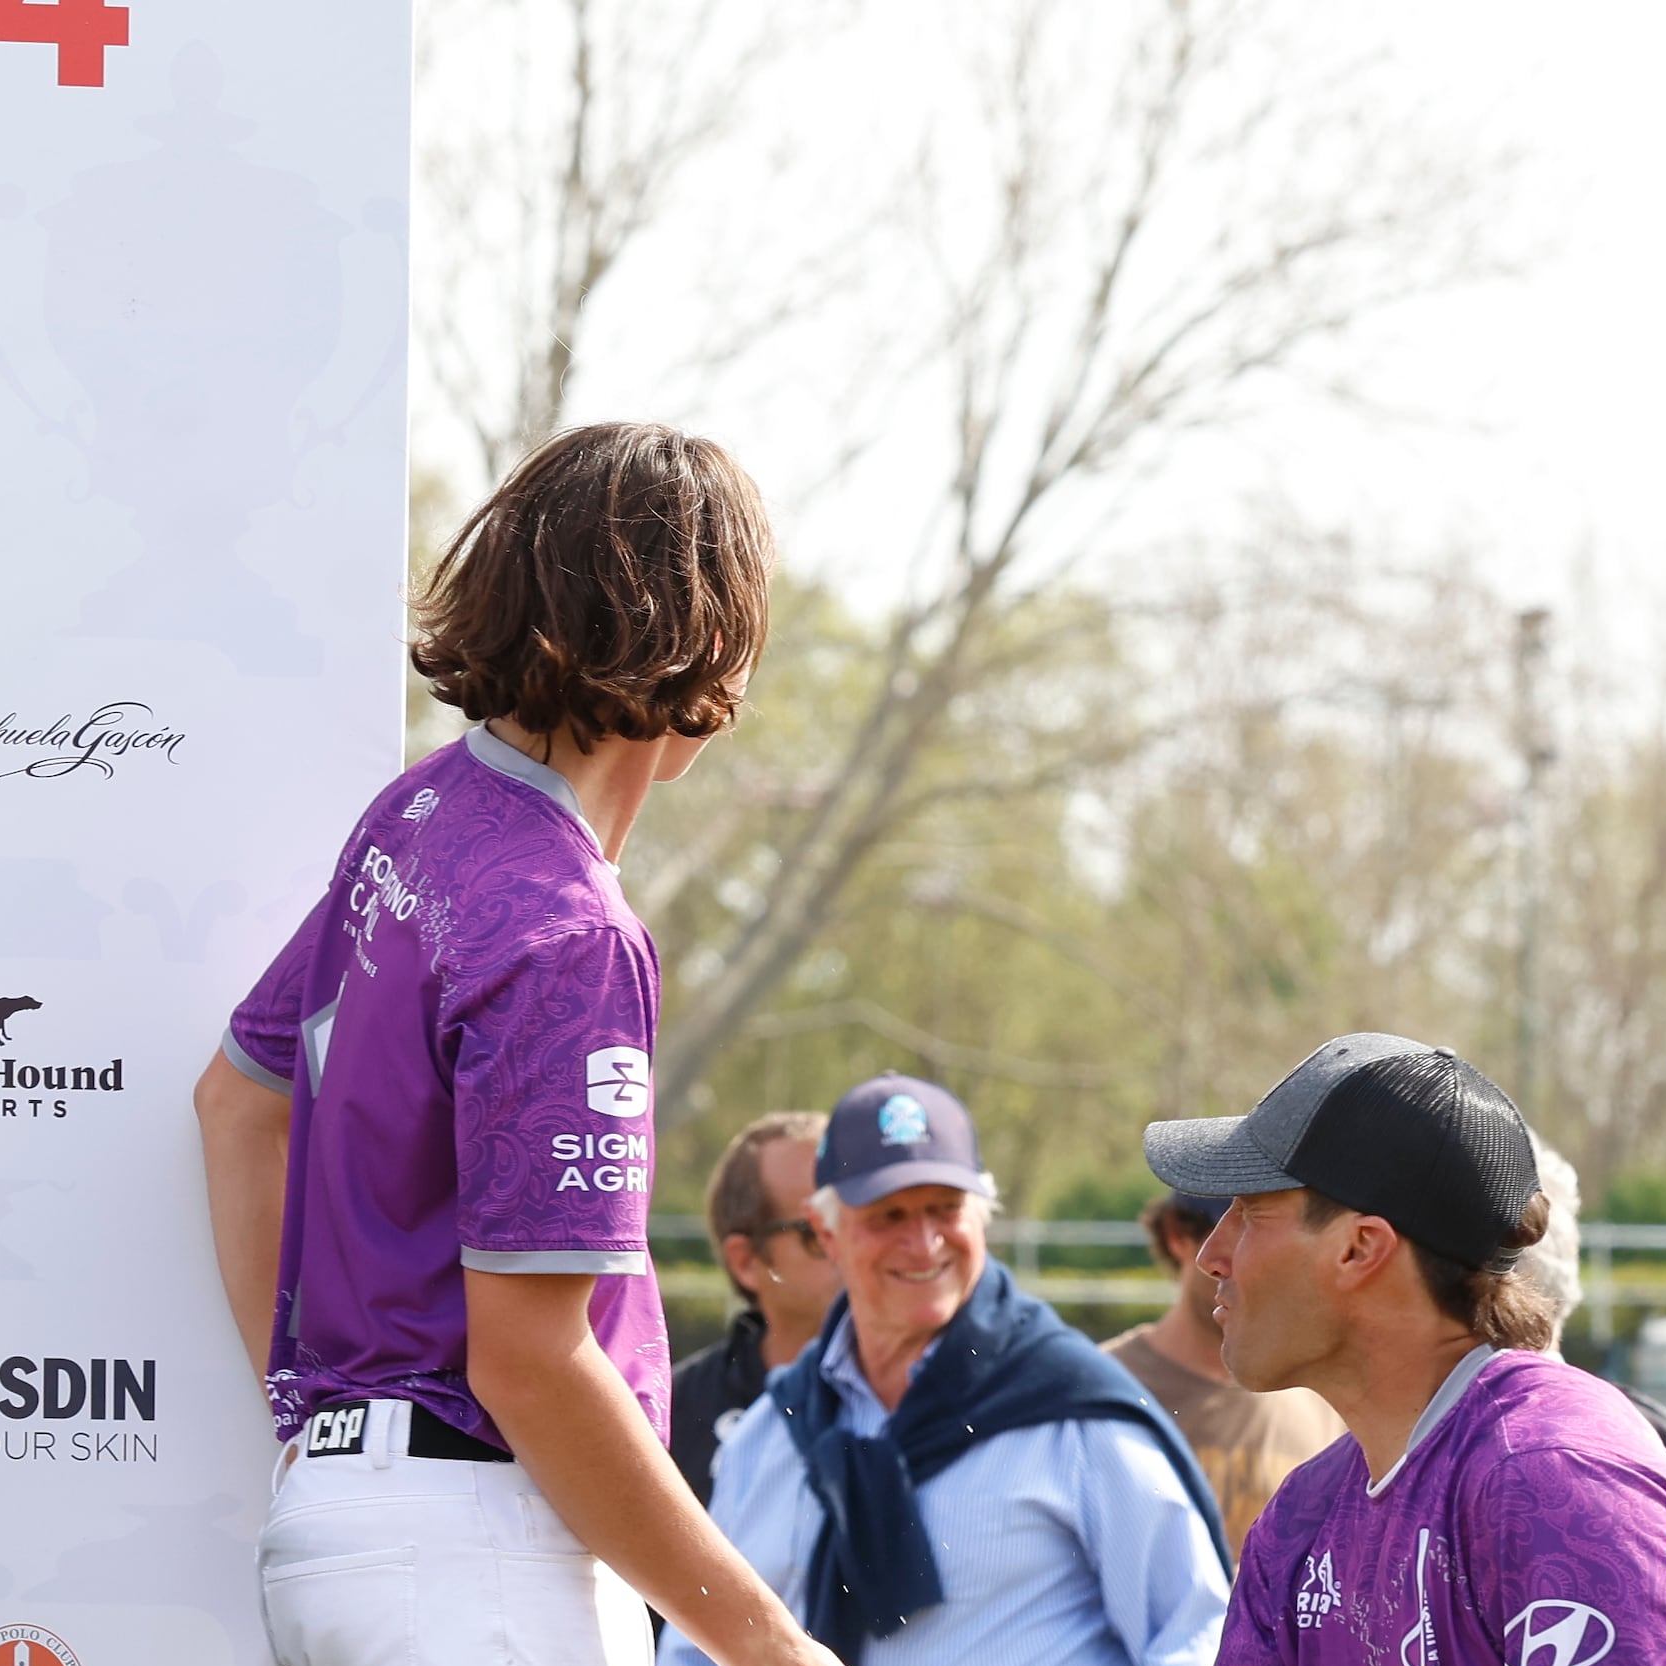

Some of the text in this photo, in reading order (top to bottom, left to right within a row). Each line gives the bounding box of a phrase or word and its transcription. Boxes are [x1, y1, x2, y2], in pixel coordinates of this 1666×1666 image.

[550, 1132, 649, 1161] SIGM
[555, 1164, 649, 1193] AGR
[70, 1432, 157, 1463] SKIN
[0, 1627, 41, 1643] POLO
